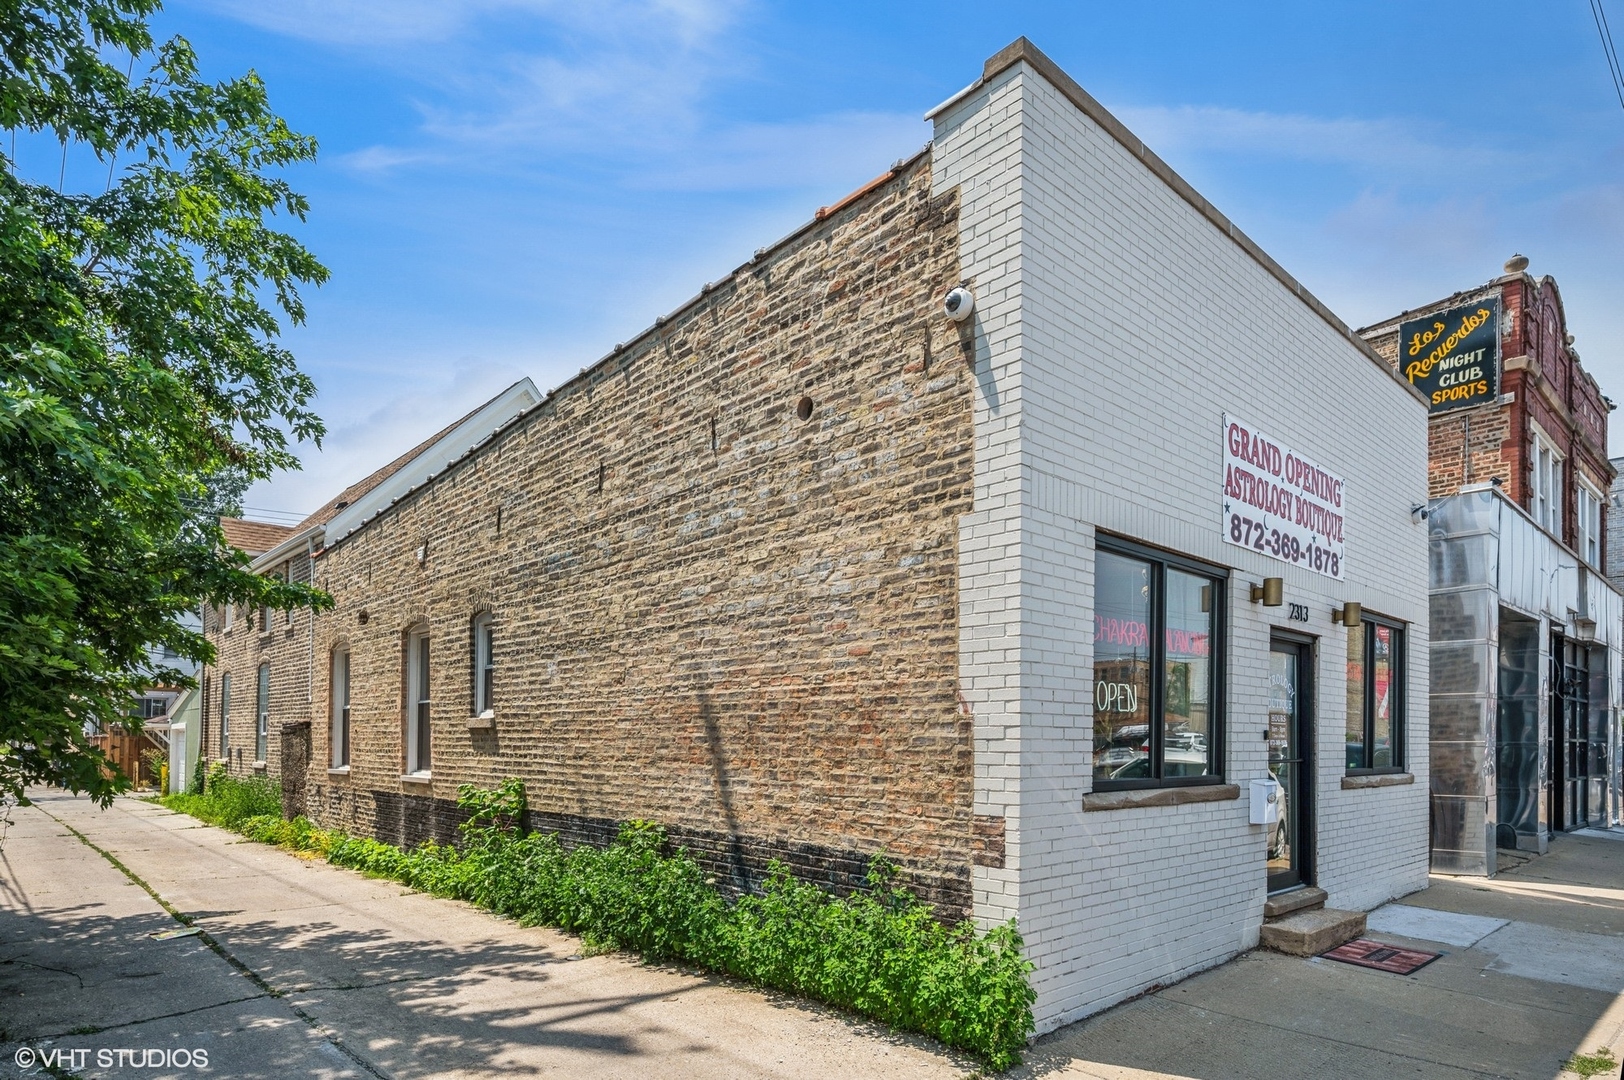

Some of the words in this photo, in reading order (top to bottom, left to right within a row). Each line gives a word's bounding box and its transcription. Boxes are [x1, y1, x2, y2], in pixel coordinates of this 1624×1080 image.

[1406, 308, 1490, 384] Recuerdos
[1408, 322, 1445, 356] Los
[1439, 348, 1486, 371] NIGHT
[1432, 380, 1487, 405] SPORTS
[1439, 366, 1483, 387] CLUB
[1228, 423, 1282, 477] GRAND
[1285, 453, 1342, 508] OPENING
[1224, 463, 1293, 522] ASTROLOGY
[1295, 495, 1343, 547] BOUTIQUE
[1230, 513, 1339, 577] 872-369-1878
[1289, 603, 1309, 623] 2313
[1094, 614, 1150, 647] CHAKRA
[1097, 681, 1138, 712] OPEN
[1271, 714, 1286, 722] HOURS
